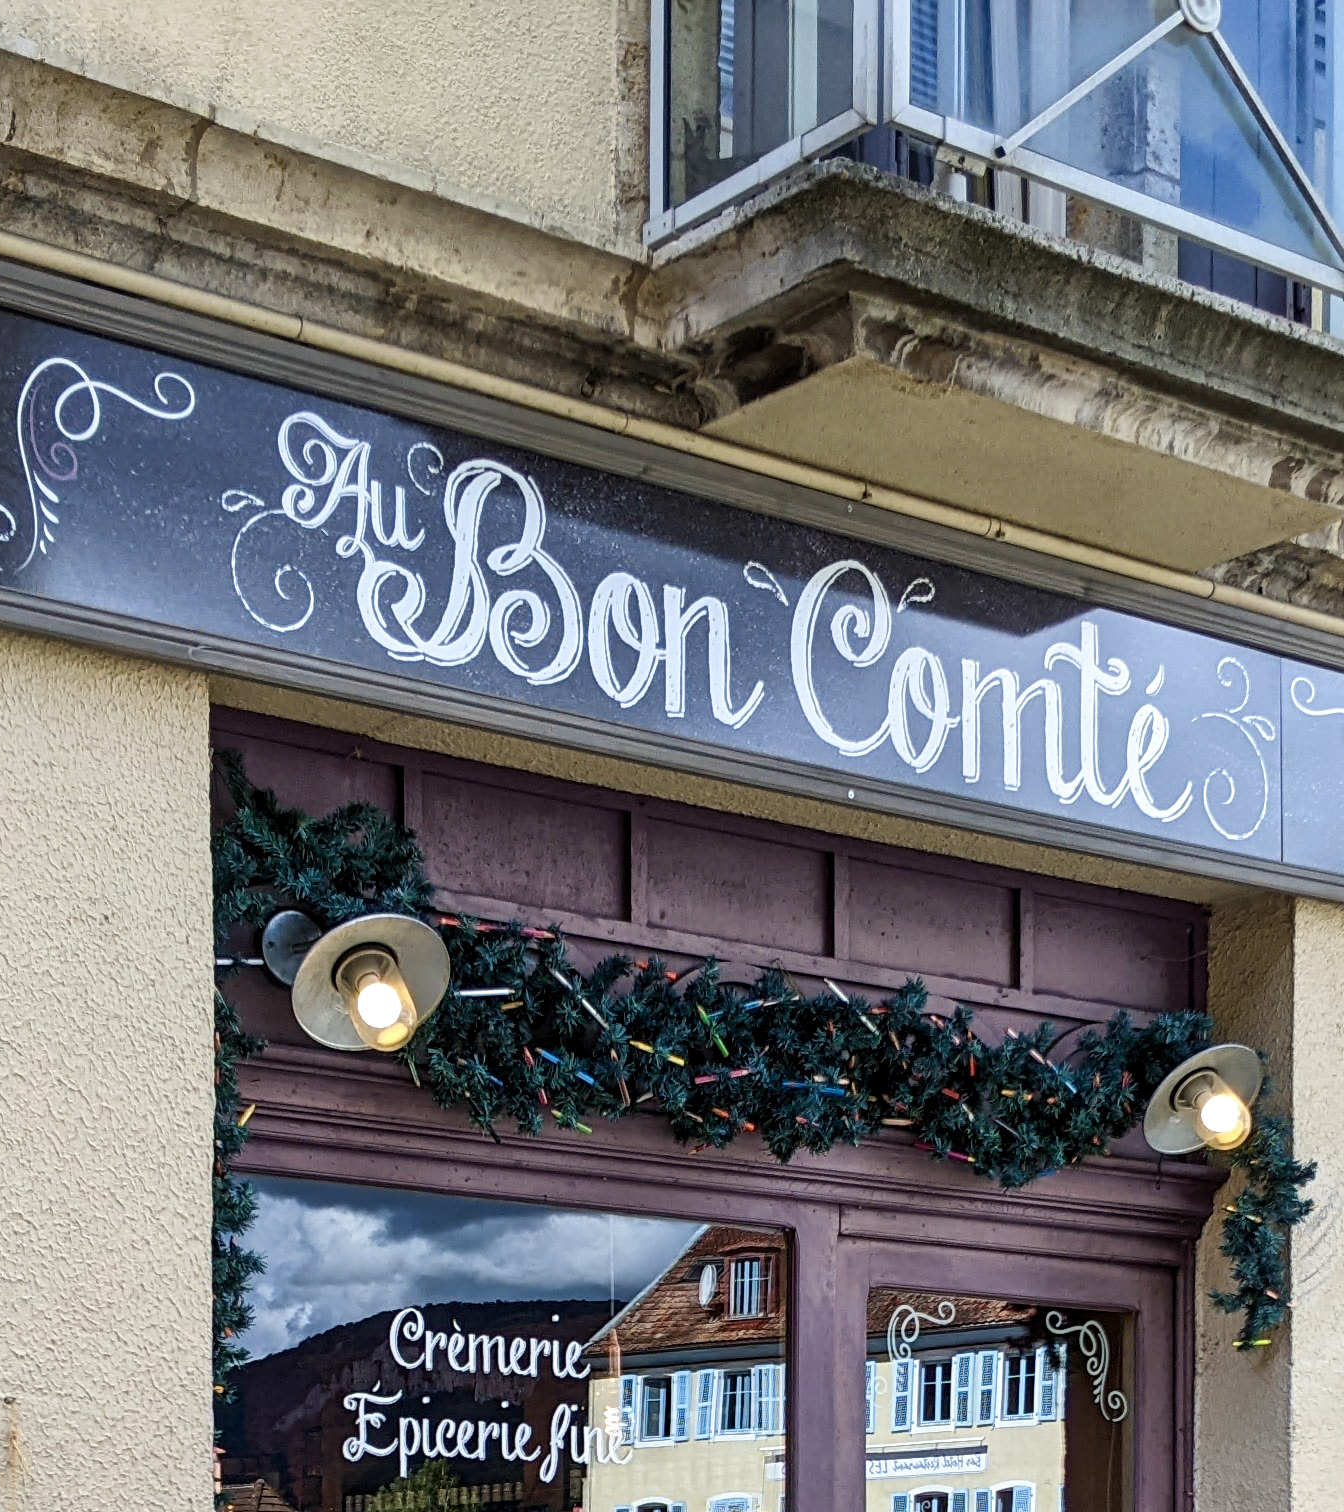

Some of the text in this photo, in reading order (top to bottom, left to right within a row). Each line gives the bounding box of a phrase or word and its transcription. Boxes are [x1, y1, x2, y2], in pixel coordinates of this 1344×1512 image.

[276, 410, 1193, 823] Au Bon Comté
[390, 1307, 591, 1380] Crèmerie
[343, 1380, 633, 1484] Épicerie fine
